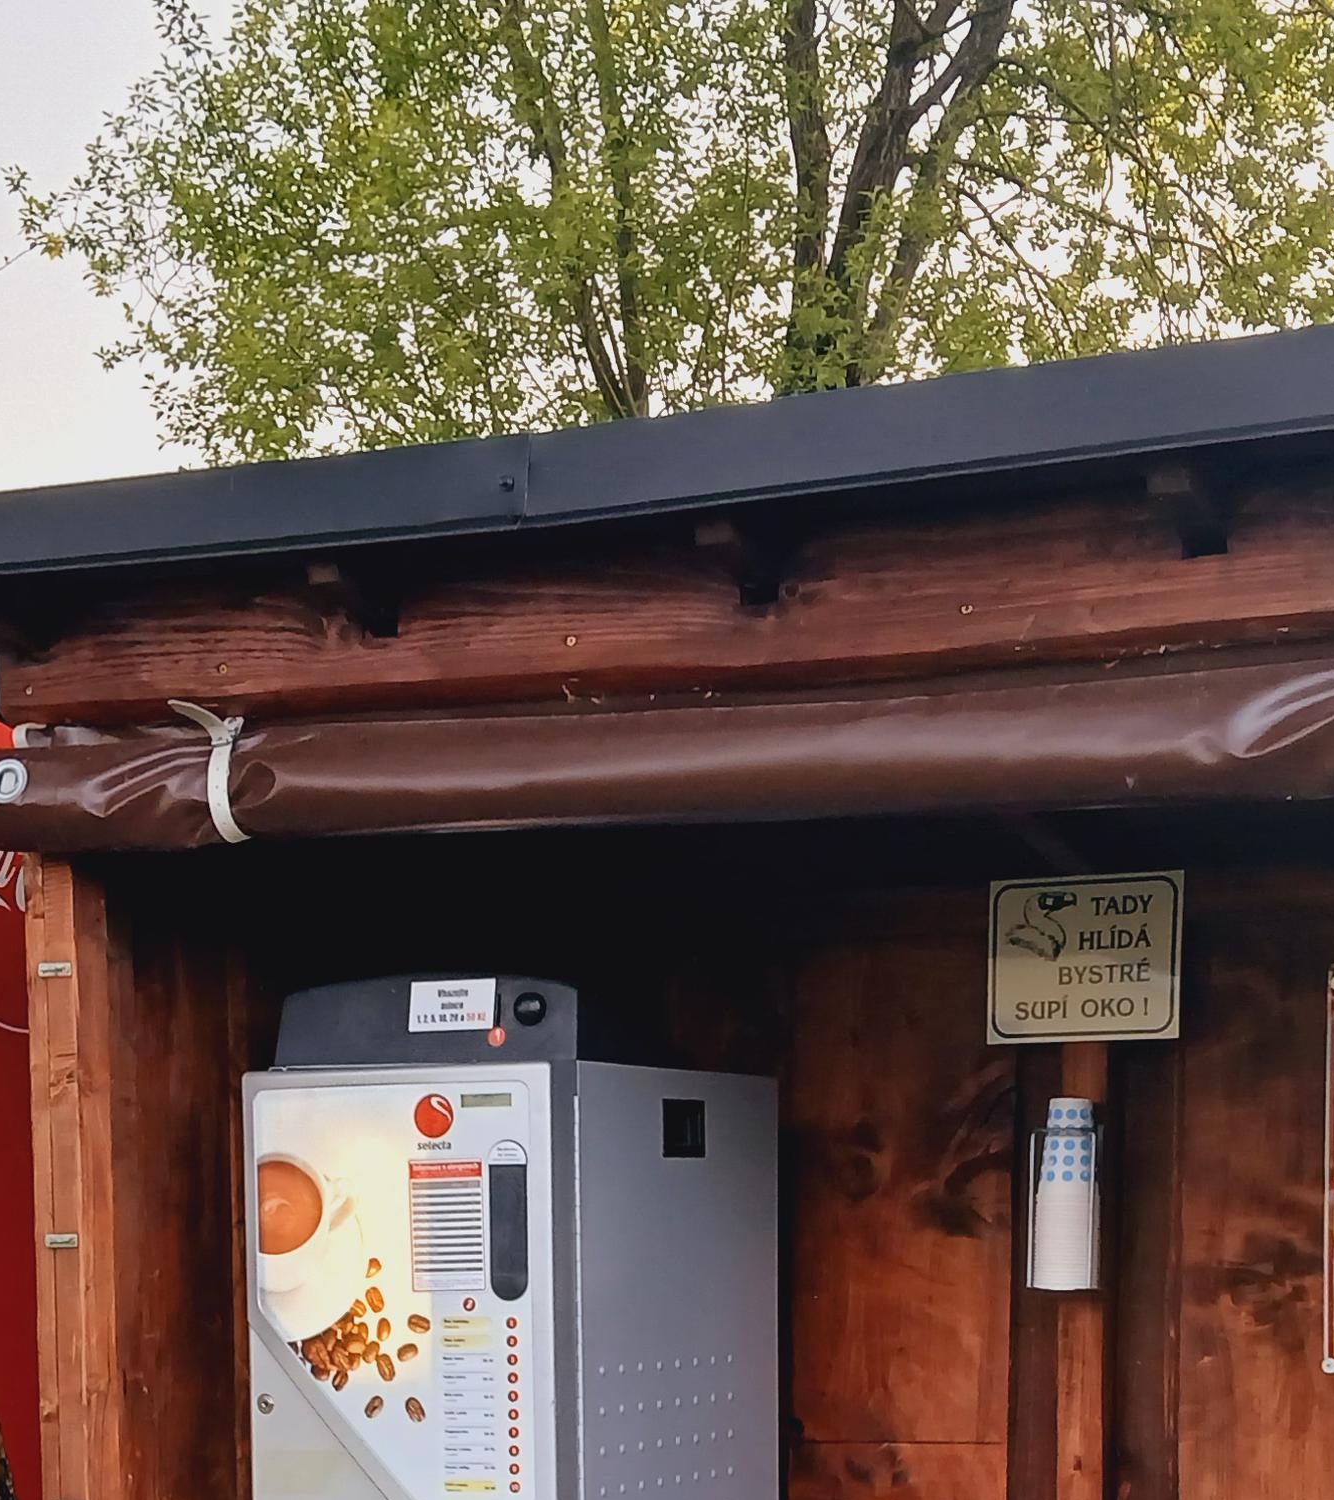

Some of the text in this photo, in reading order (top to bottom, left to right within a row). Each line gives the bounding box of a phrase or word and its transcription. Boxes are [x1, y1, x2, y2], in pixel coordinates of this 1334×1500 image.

[1091, 894, 1153, 916] TADY
[1078, 923, 1151, 950] HLÍDÁ
[1058, 957, 1150, 985] BYSTRÉ
[1015, 995, 1149, 1020] SUPÍ OKO !
[417, 1141, 452, 1151] selecta
